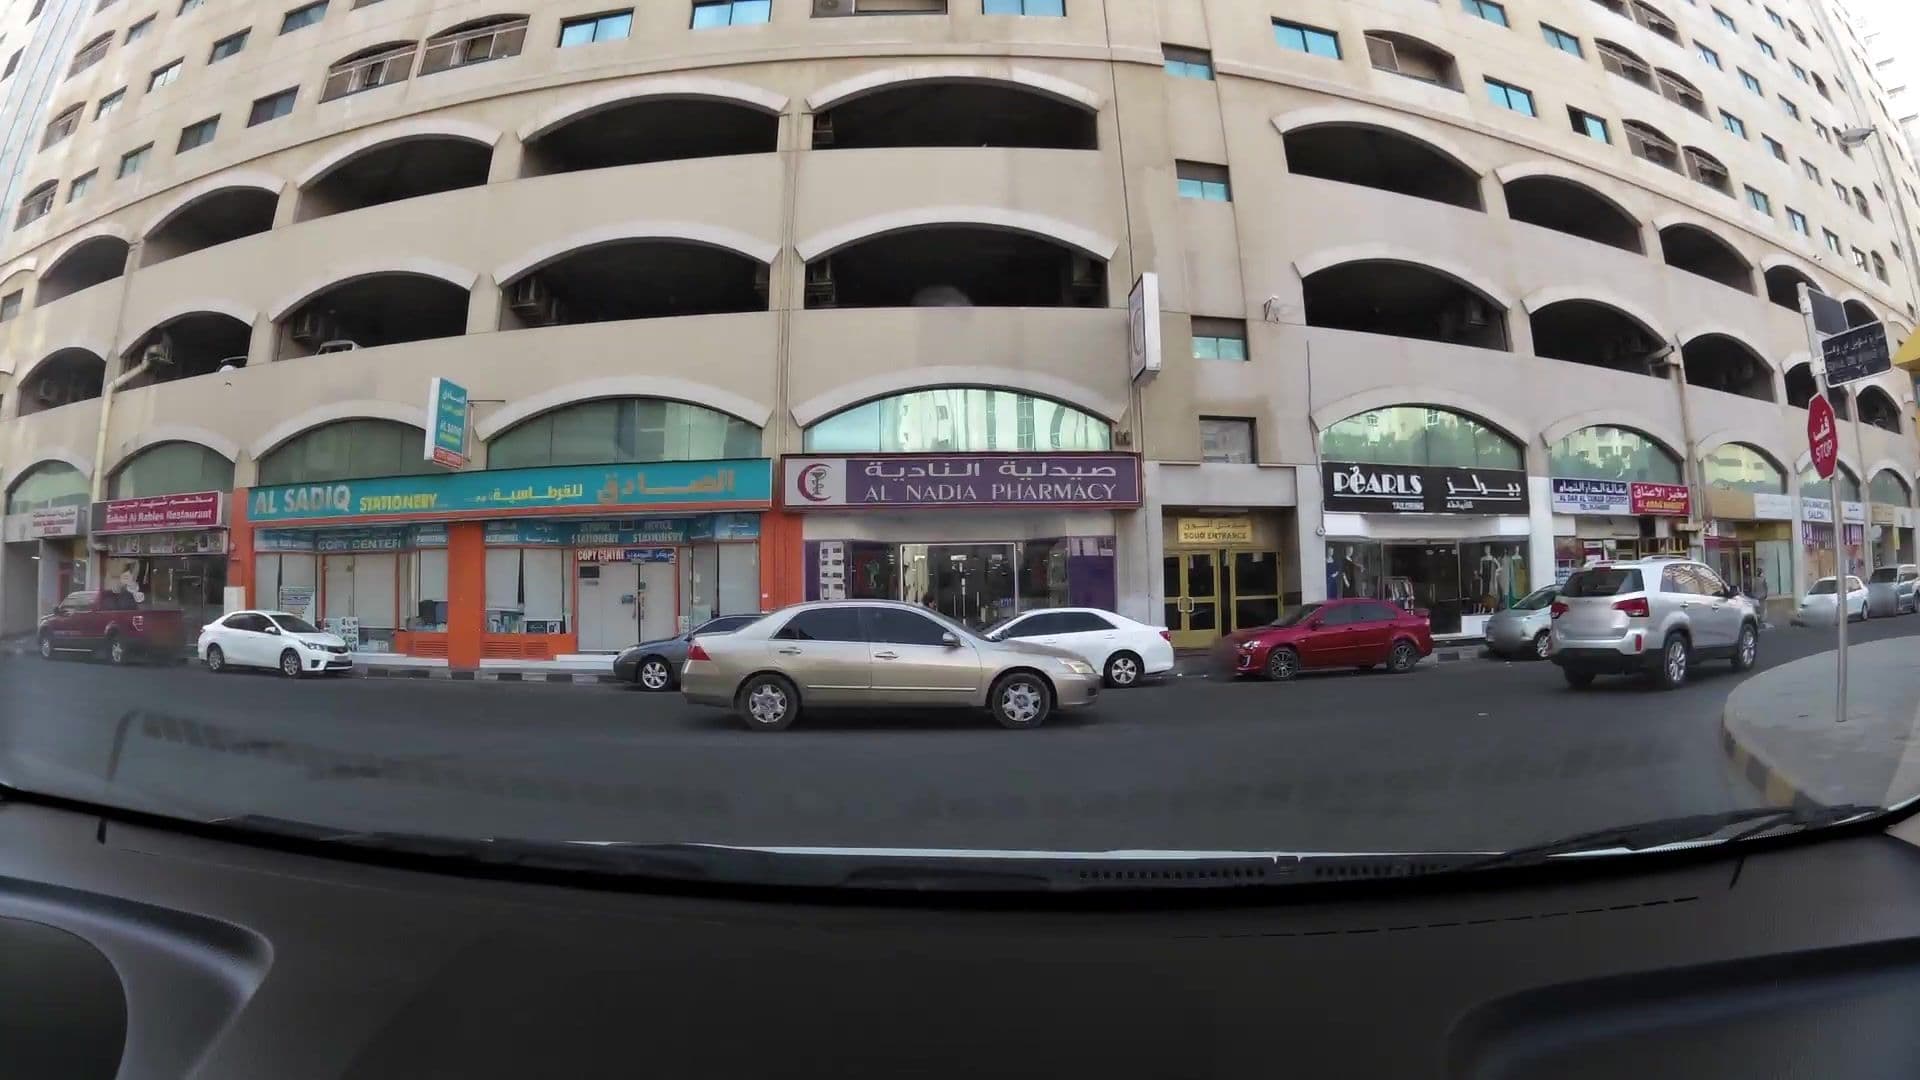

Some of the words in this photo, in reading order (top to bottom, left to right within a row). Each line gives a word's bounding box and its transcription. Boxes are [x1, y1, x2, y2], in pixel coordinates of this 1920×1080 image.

[1815, 439, 1833, 463] STOP
[865, 461, 980, 481] النادية
[998, 461, 1117, 481] صيدلية
[254, 490, 278, 515] AL
[284, 485, 351, 513] SADIQ
[359, 493, 437, 512] STATIONERY
[865, 487, 893, 502] AL
[906, 484, 977, 501] NADIA
[992, 483, 1117, 500] PHARMACY
[166, 510, 212, 521] Restaurant
[1207, 532, 1247, 540] ENTRANCE
[577, 550, 597, 561] COPY
